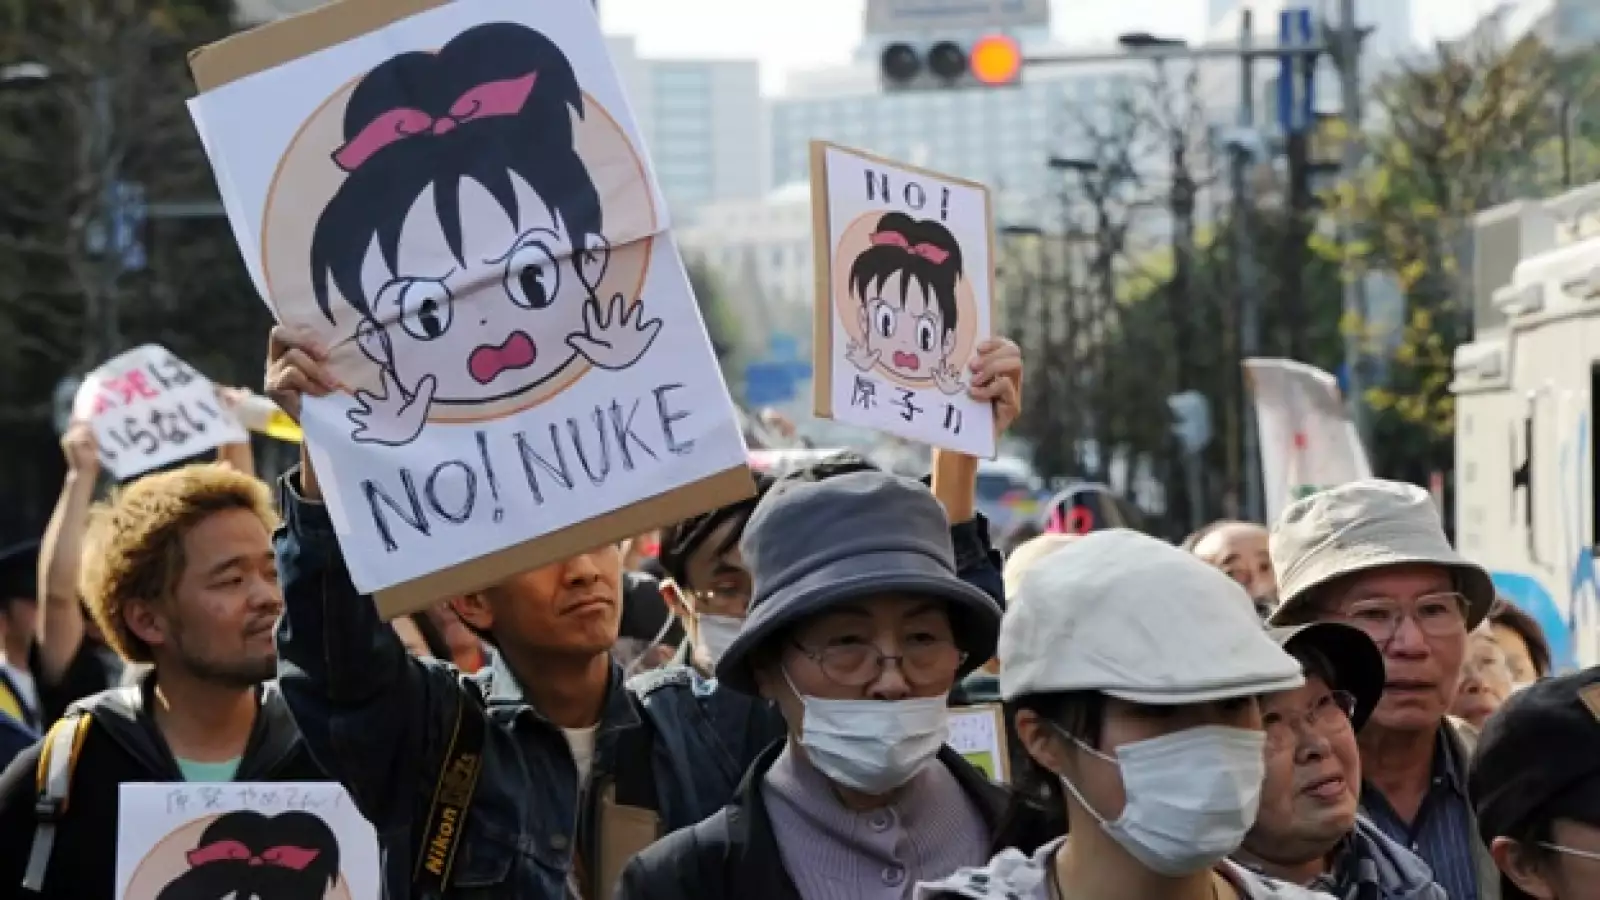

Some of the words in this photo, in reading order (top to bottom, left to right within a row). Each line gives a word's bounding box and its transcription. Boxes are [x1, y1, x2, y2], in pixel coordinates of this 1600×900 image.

[863, 168, 950, 221] NO!
[359, 429, 504, 552] NO!
[512, 382, 697, 505] NUKE
[424, 806, 458, 876] Nikon
